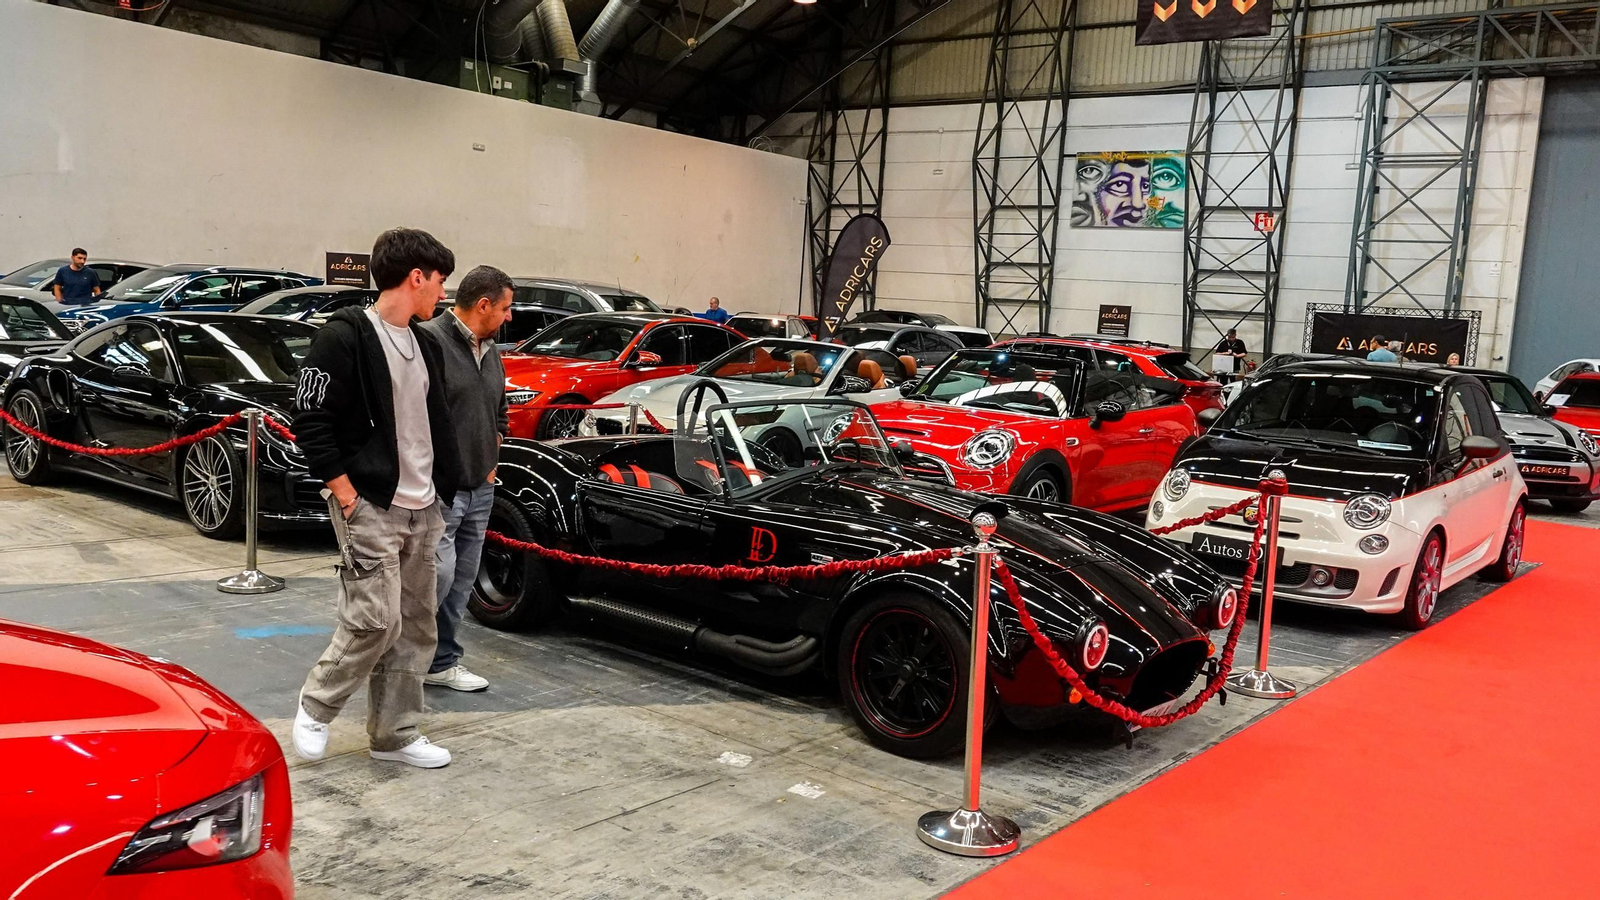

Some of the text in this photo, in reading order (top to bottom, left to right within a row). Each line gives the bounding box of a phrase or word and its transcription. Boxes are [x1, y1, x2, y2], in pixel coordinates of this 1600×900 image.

[330, 263, 367, 272] ADRICARS
[836, 236, 883, 312] ADRICARS
[1531, 465, 1568, 475] ADRICARS
[1197, 536, 1243, 559] Autos
